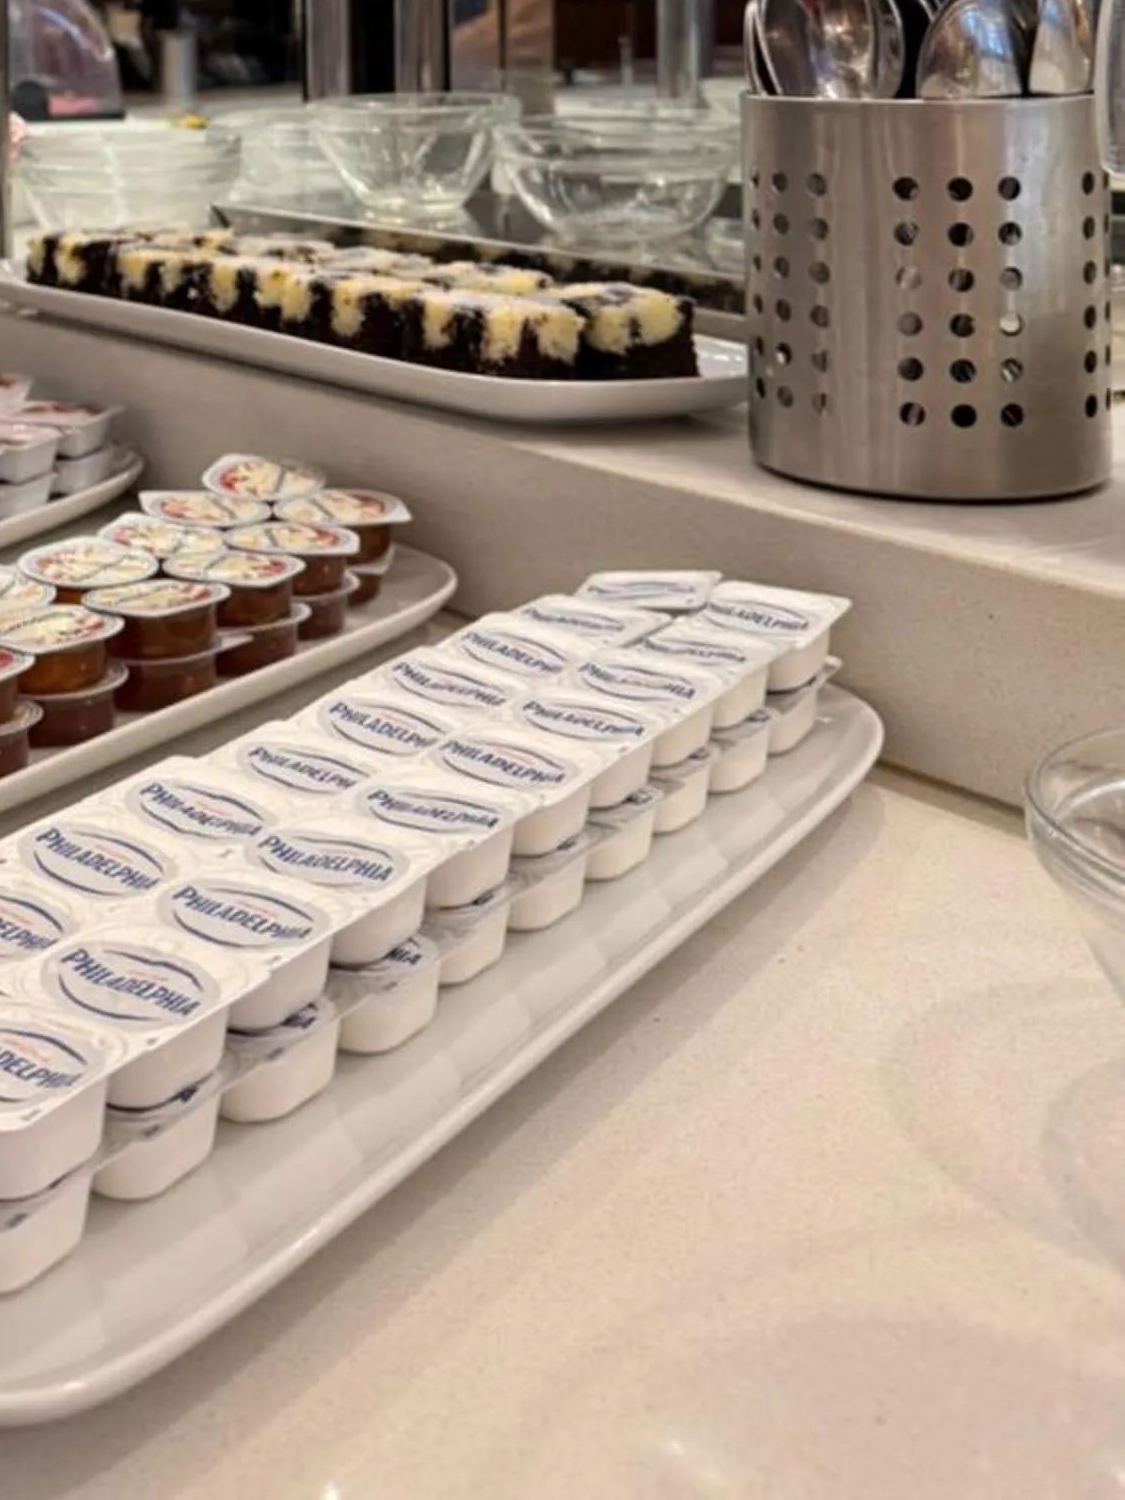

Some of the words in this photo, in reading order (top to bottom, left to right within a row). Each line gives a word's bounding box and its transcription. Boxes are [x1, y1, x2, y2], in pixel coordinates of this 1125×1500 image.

[36, 827, 160, 889] PHILADELPHIA
[257, 835, 394, 882] PHILADELPHIA
[60, 948, 201, 1016] PHILADELPHIA
